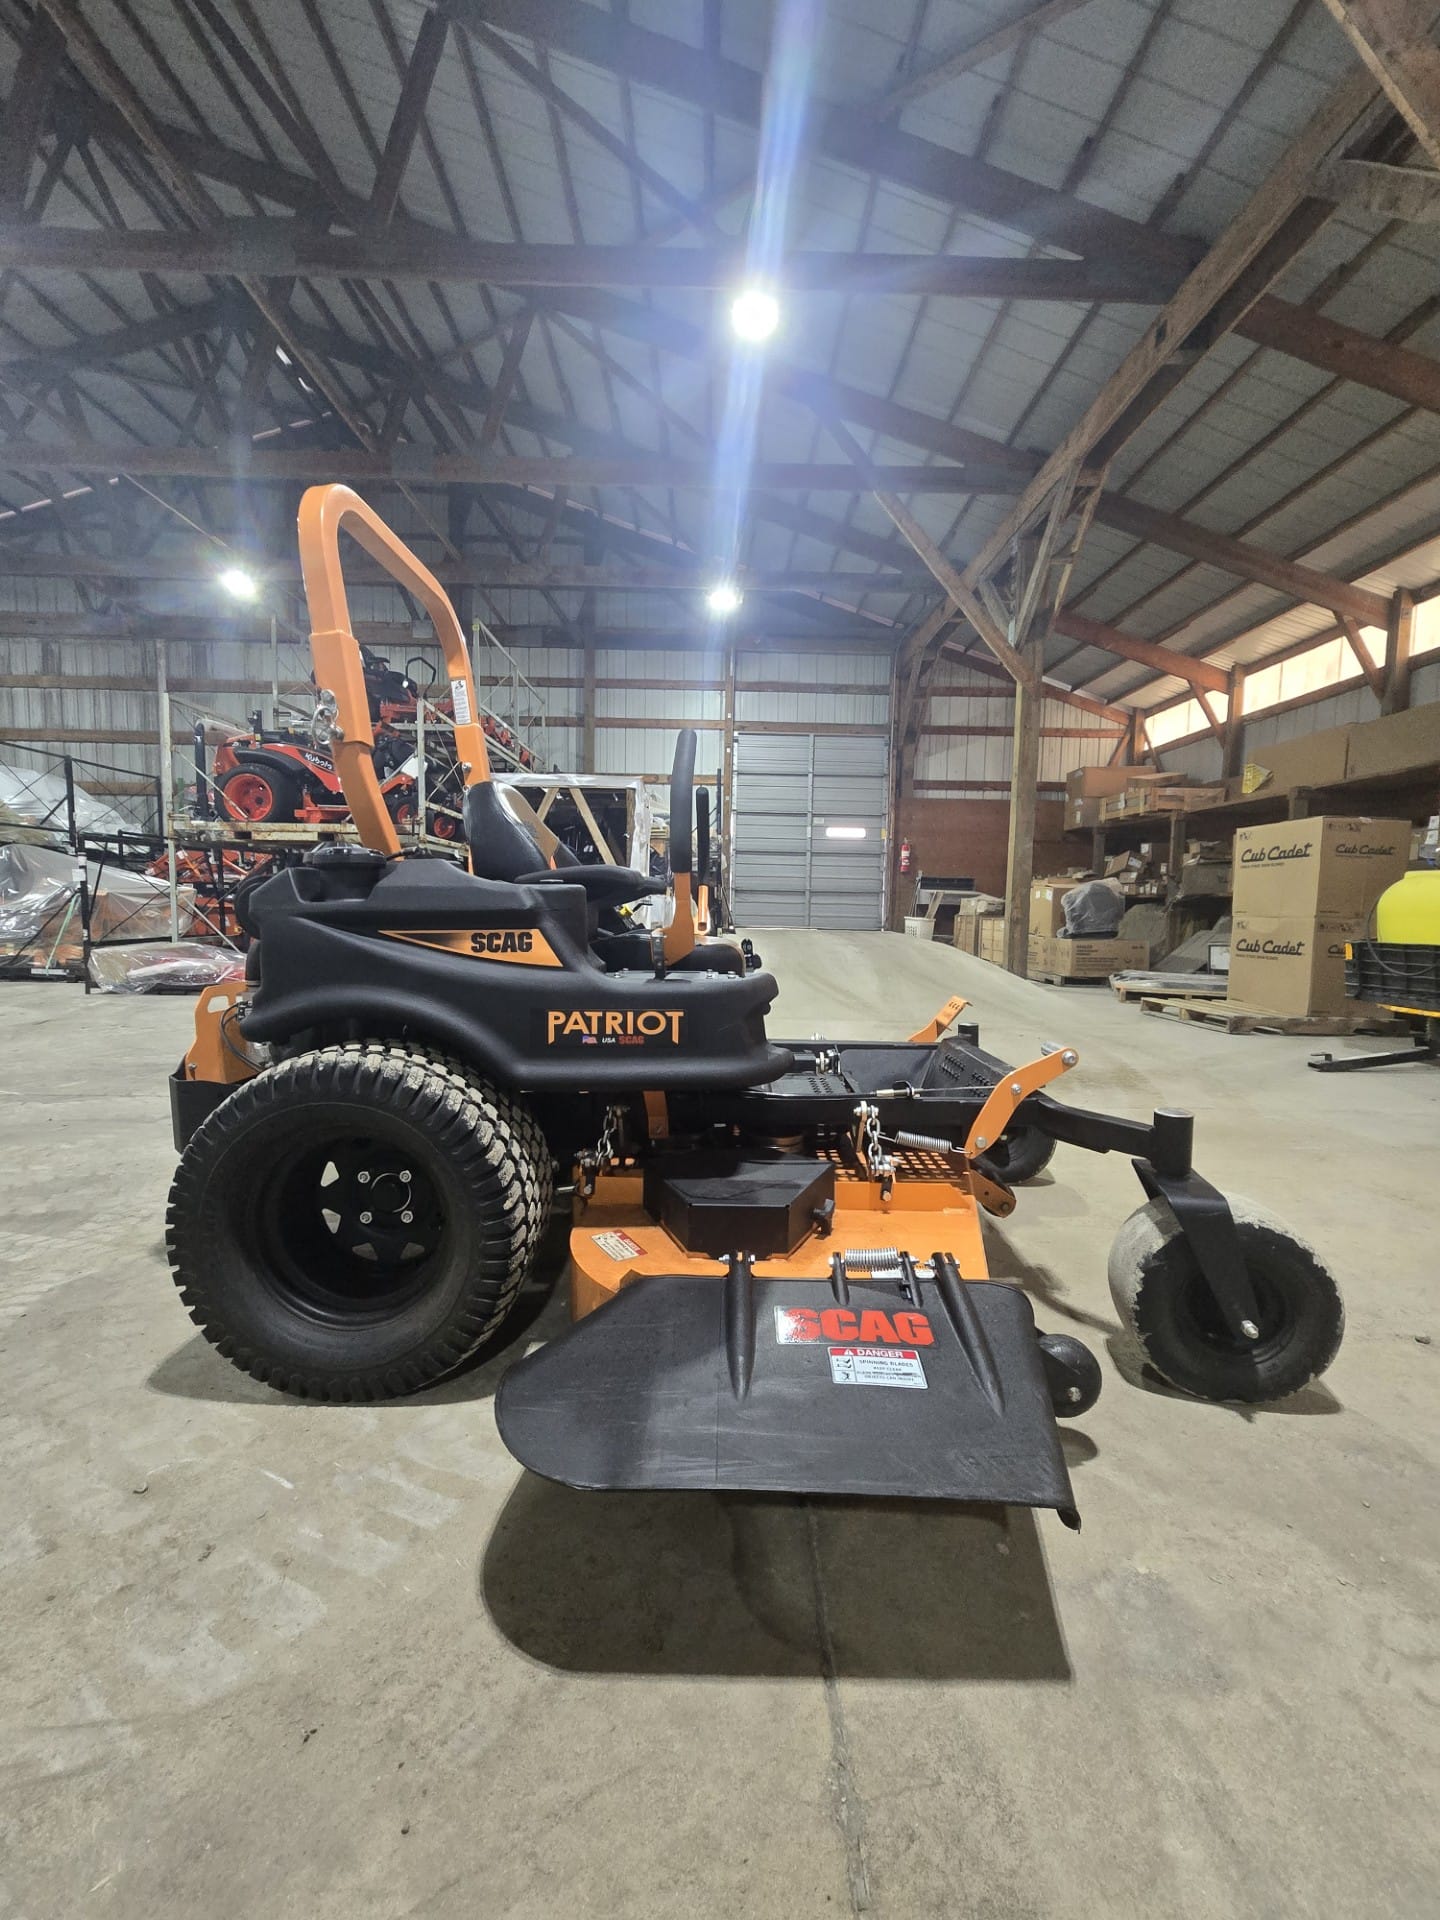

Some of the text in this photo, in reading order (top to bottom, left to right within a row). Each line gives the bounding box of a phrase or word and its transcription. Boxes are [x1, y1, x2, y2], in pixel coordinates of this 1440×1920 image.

[1241, 842, 1313, 863] Cub Cadet
[1335, 843, 1396, 856] Cub Cadet
[470, 931, 533, 953] SCAG
[1236, 938, 1306, 956] Cub Cadet
[547, 1011, 685, 1045] PATRIOT
[602, 1035, 645, 1045] USA SCAG
[784, 1307, 935, 1346] SCAG
[856, 1349, 904, 1358] DANGER
